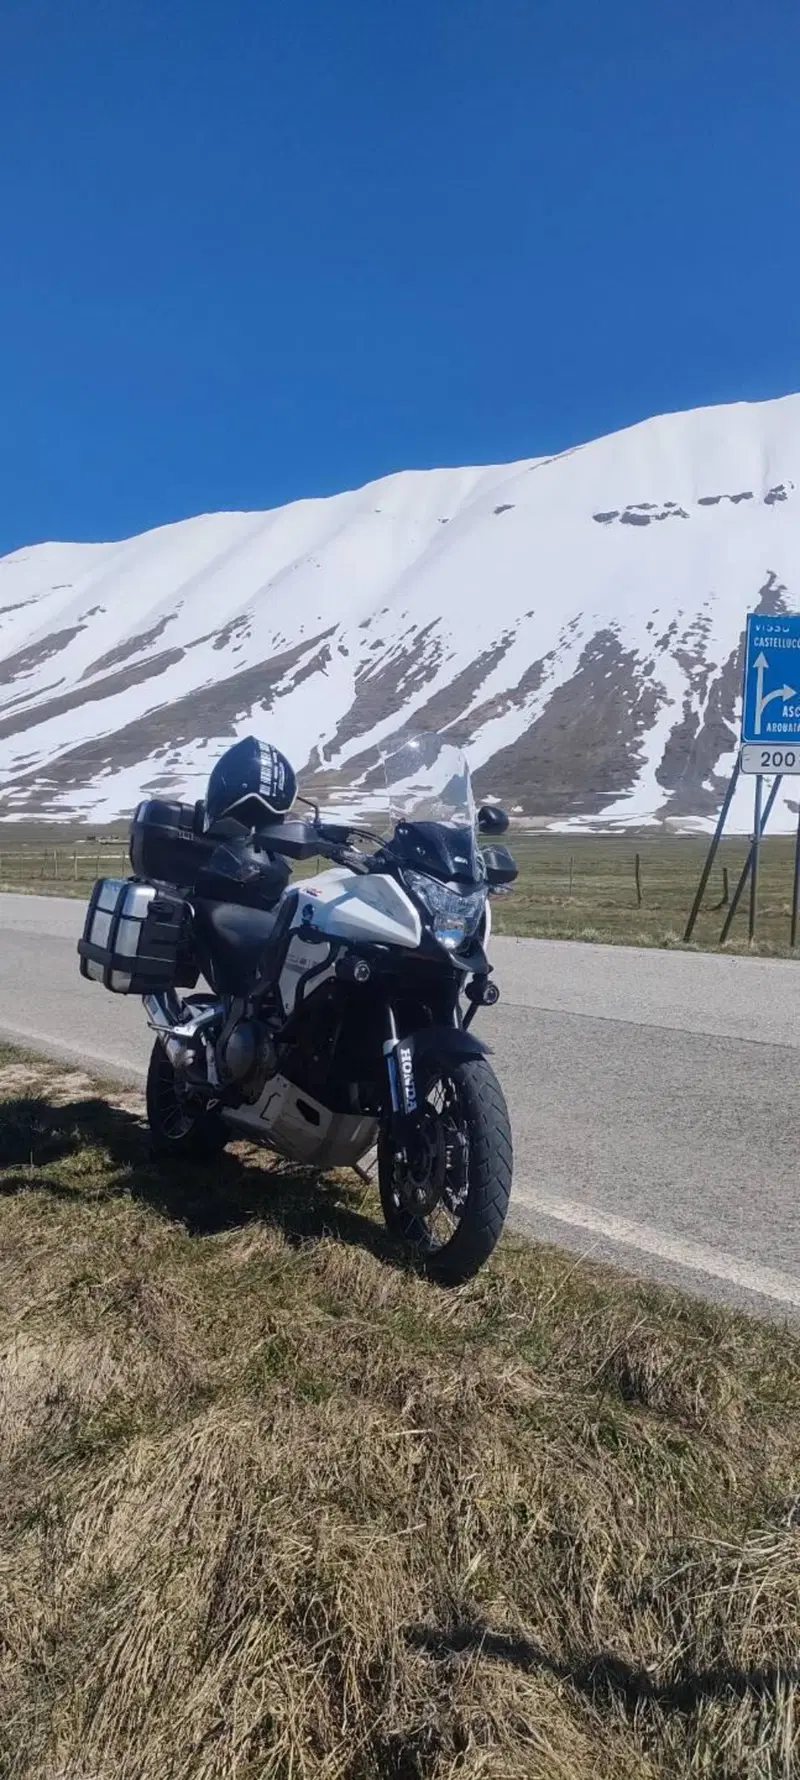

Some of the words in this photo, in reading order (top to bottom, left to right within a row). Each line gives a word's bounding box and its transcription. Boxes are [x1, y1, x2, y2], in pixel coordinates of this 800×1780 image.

[782, 705, 800, 718] ASC
[761, 751, 796, 767] 200
[400, 1048, 418, 1114] HONDA
